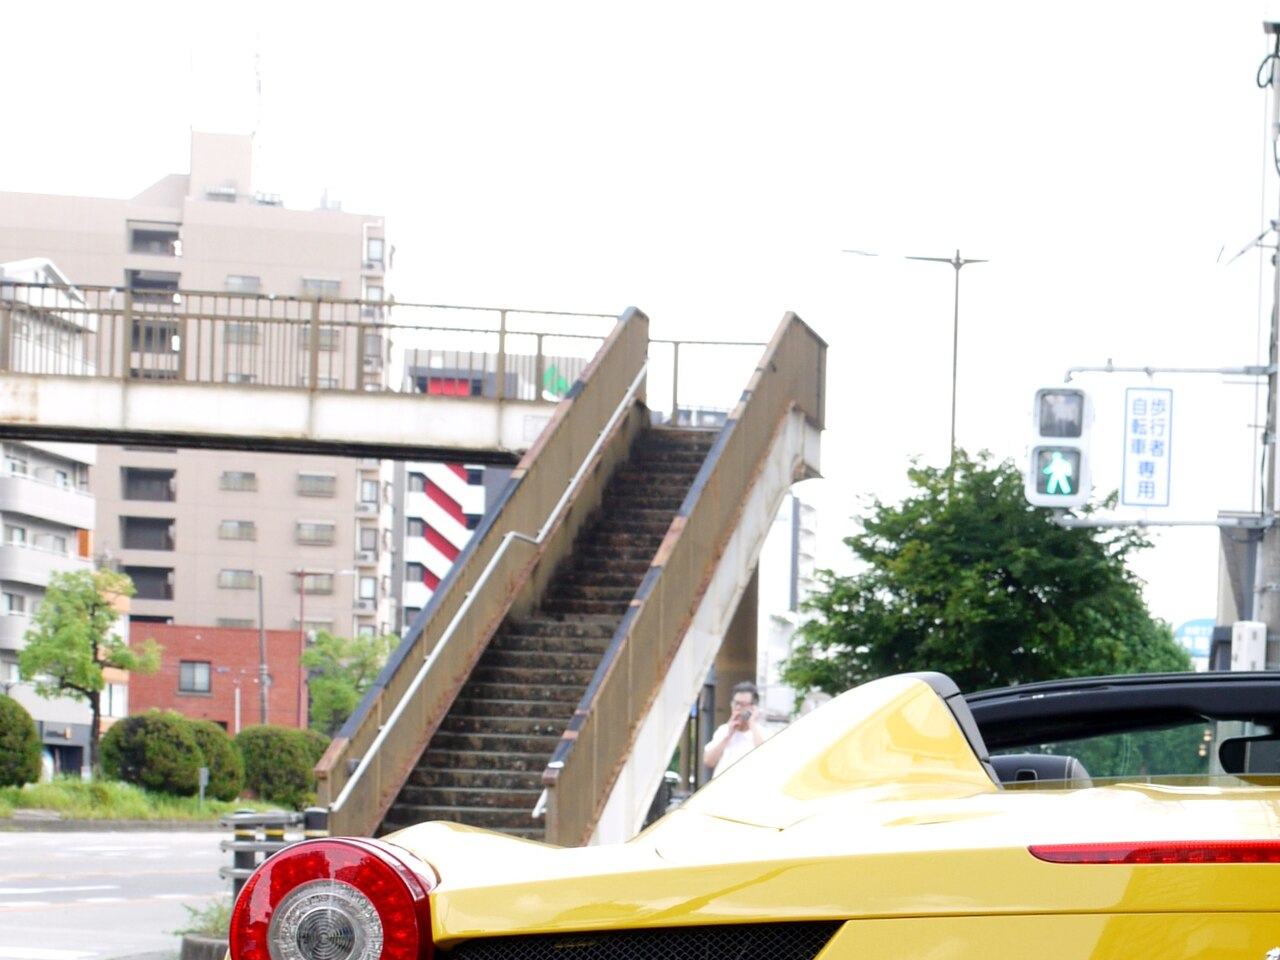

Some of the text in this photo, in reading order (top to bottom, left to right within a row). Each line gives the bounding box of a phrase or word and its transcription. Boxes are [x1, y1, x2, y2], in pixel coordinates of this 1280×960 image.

[1131, 398, 1147, 455] 自転車
[1150, 398, 1166, 457] 歩行者
[1138, 461, 1155, 499] 専用
